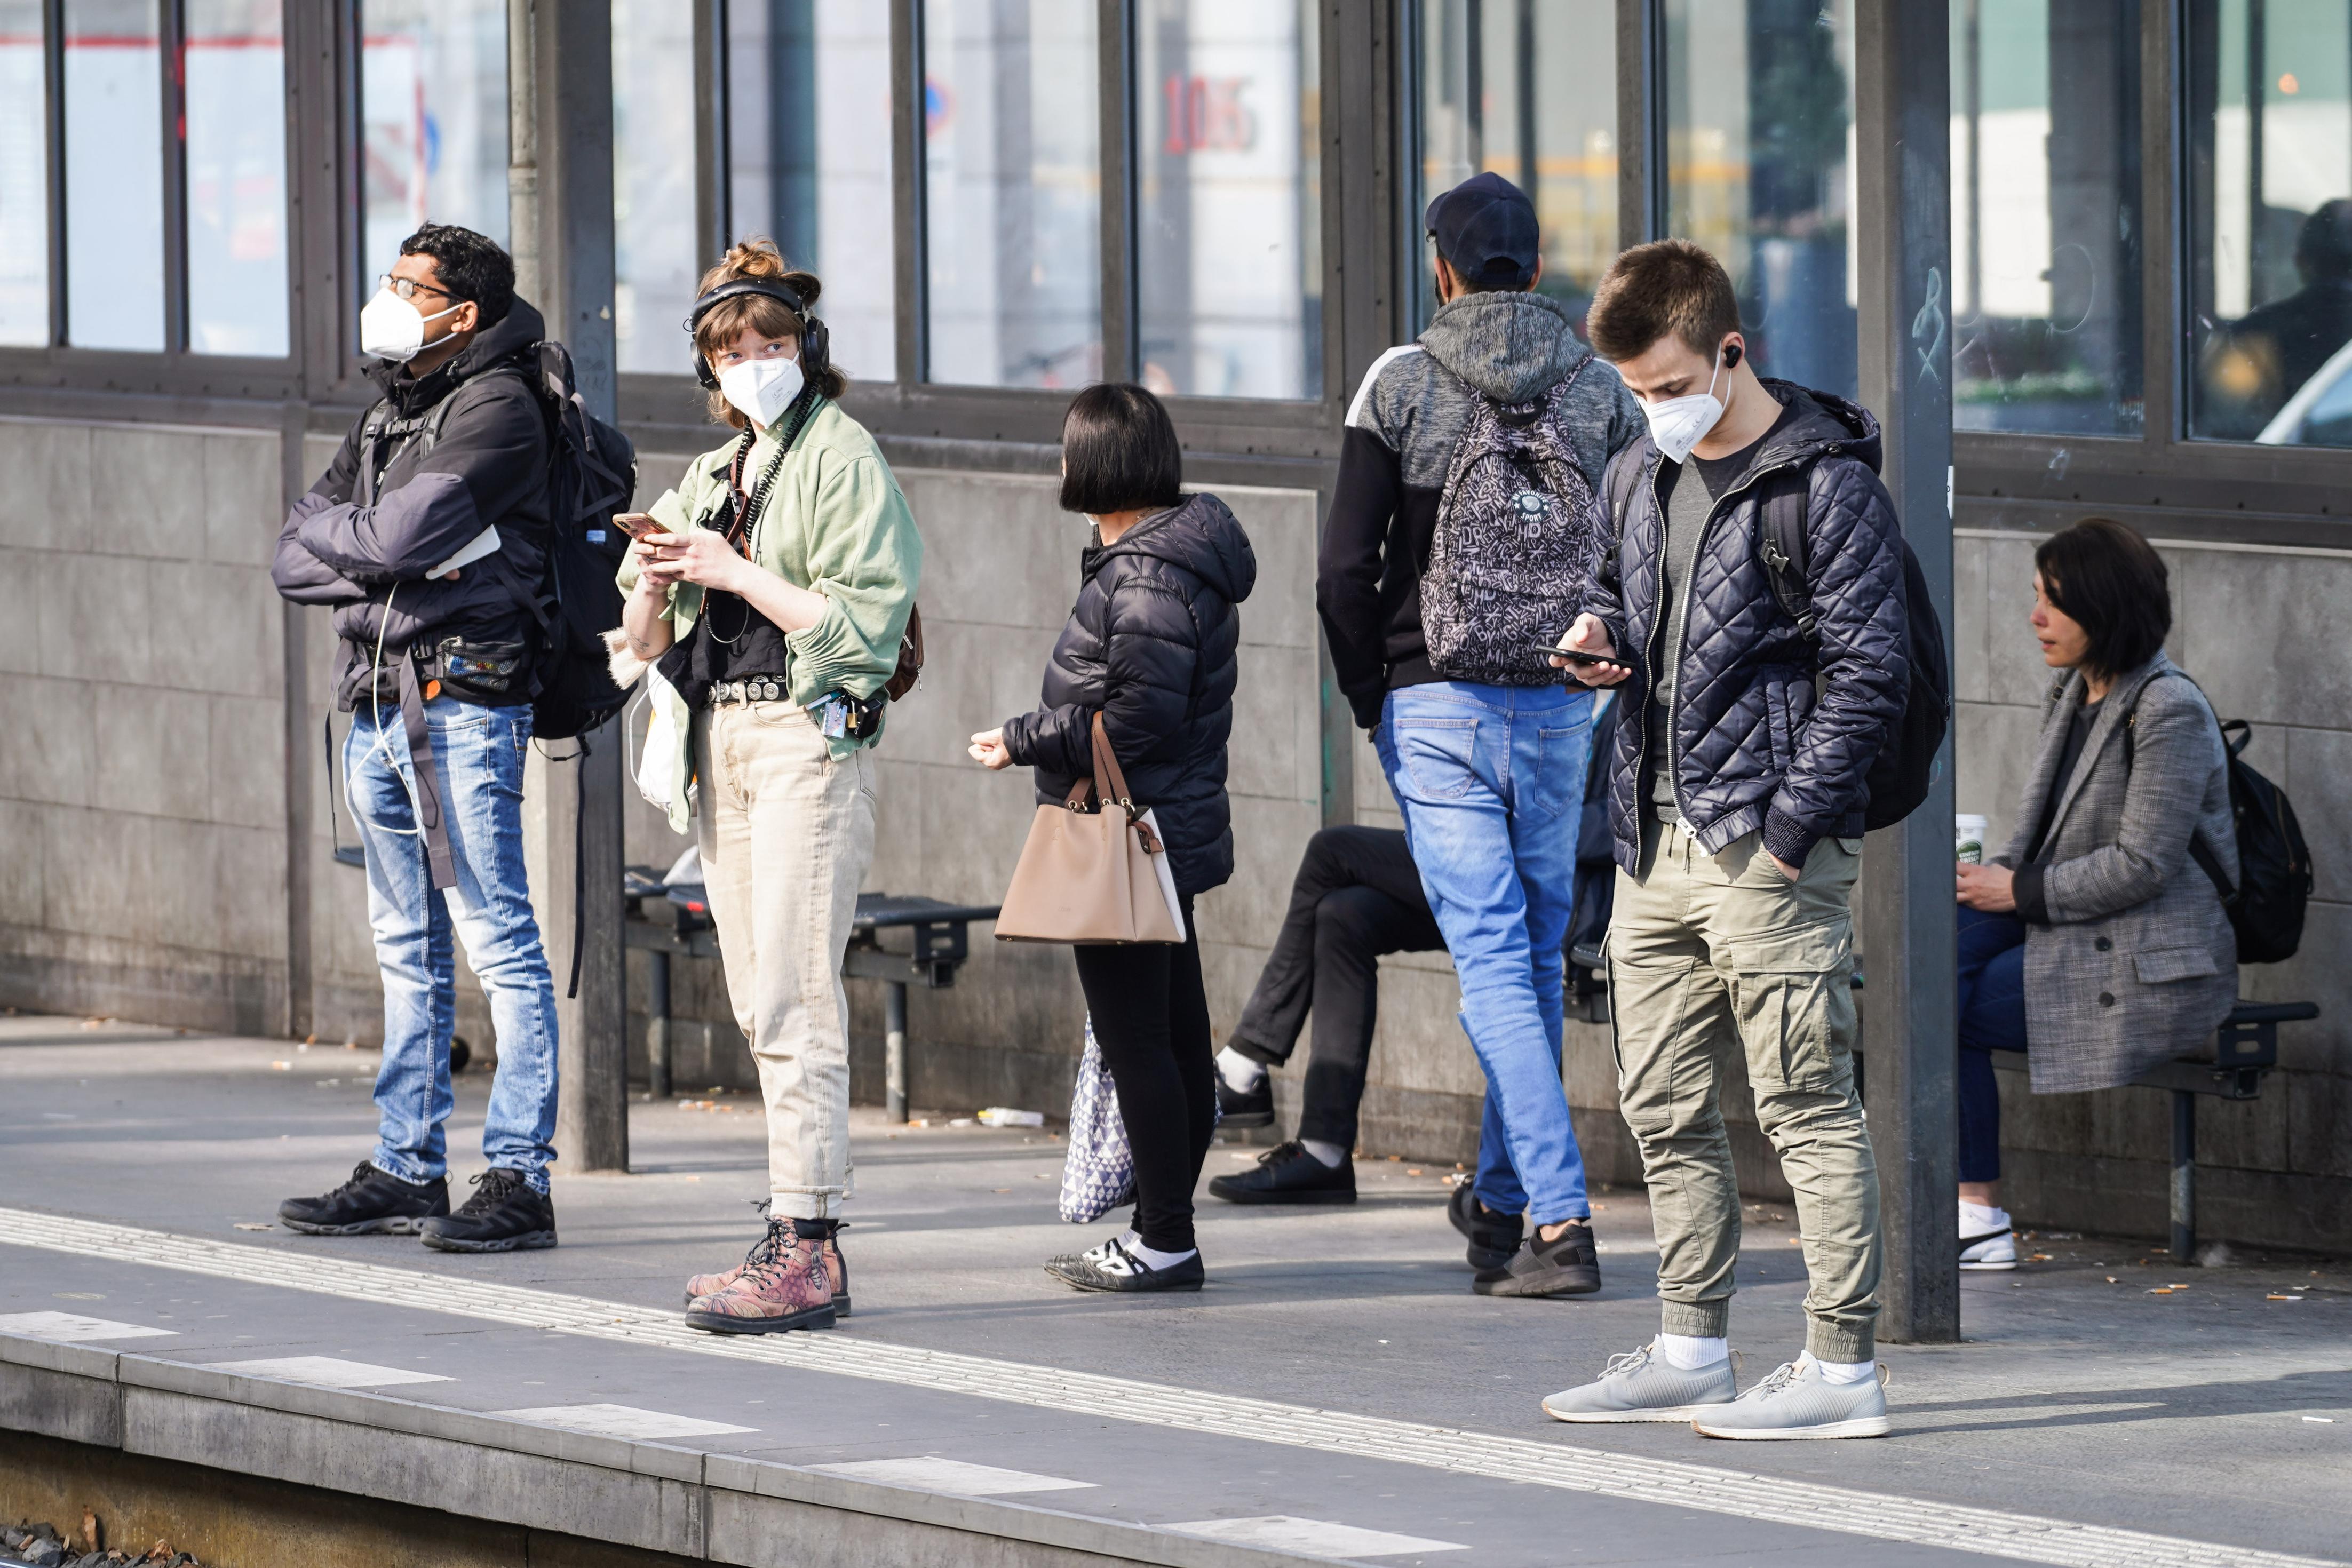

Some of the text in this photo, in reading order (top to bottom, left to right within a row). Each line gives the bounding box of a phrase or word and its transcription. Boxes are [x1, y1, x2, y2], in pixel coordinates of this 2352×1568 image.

[1512, 490, 1548, 503] MY FAVORITE
[1521, 512, 1542, 522] SPORT
